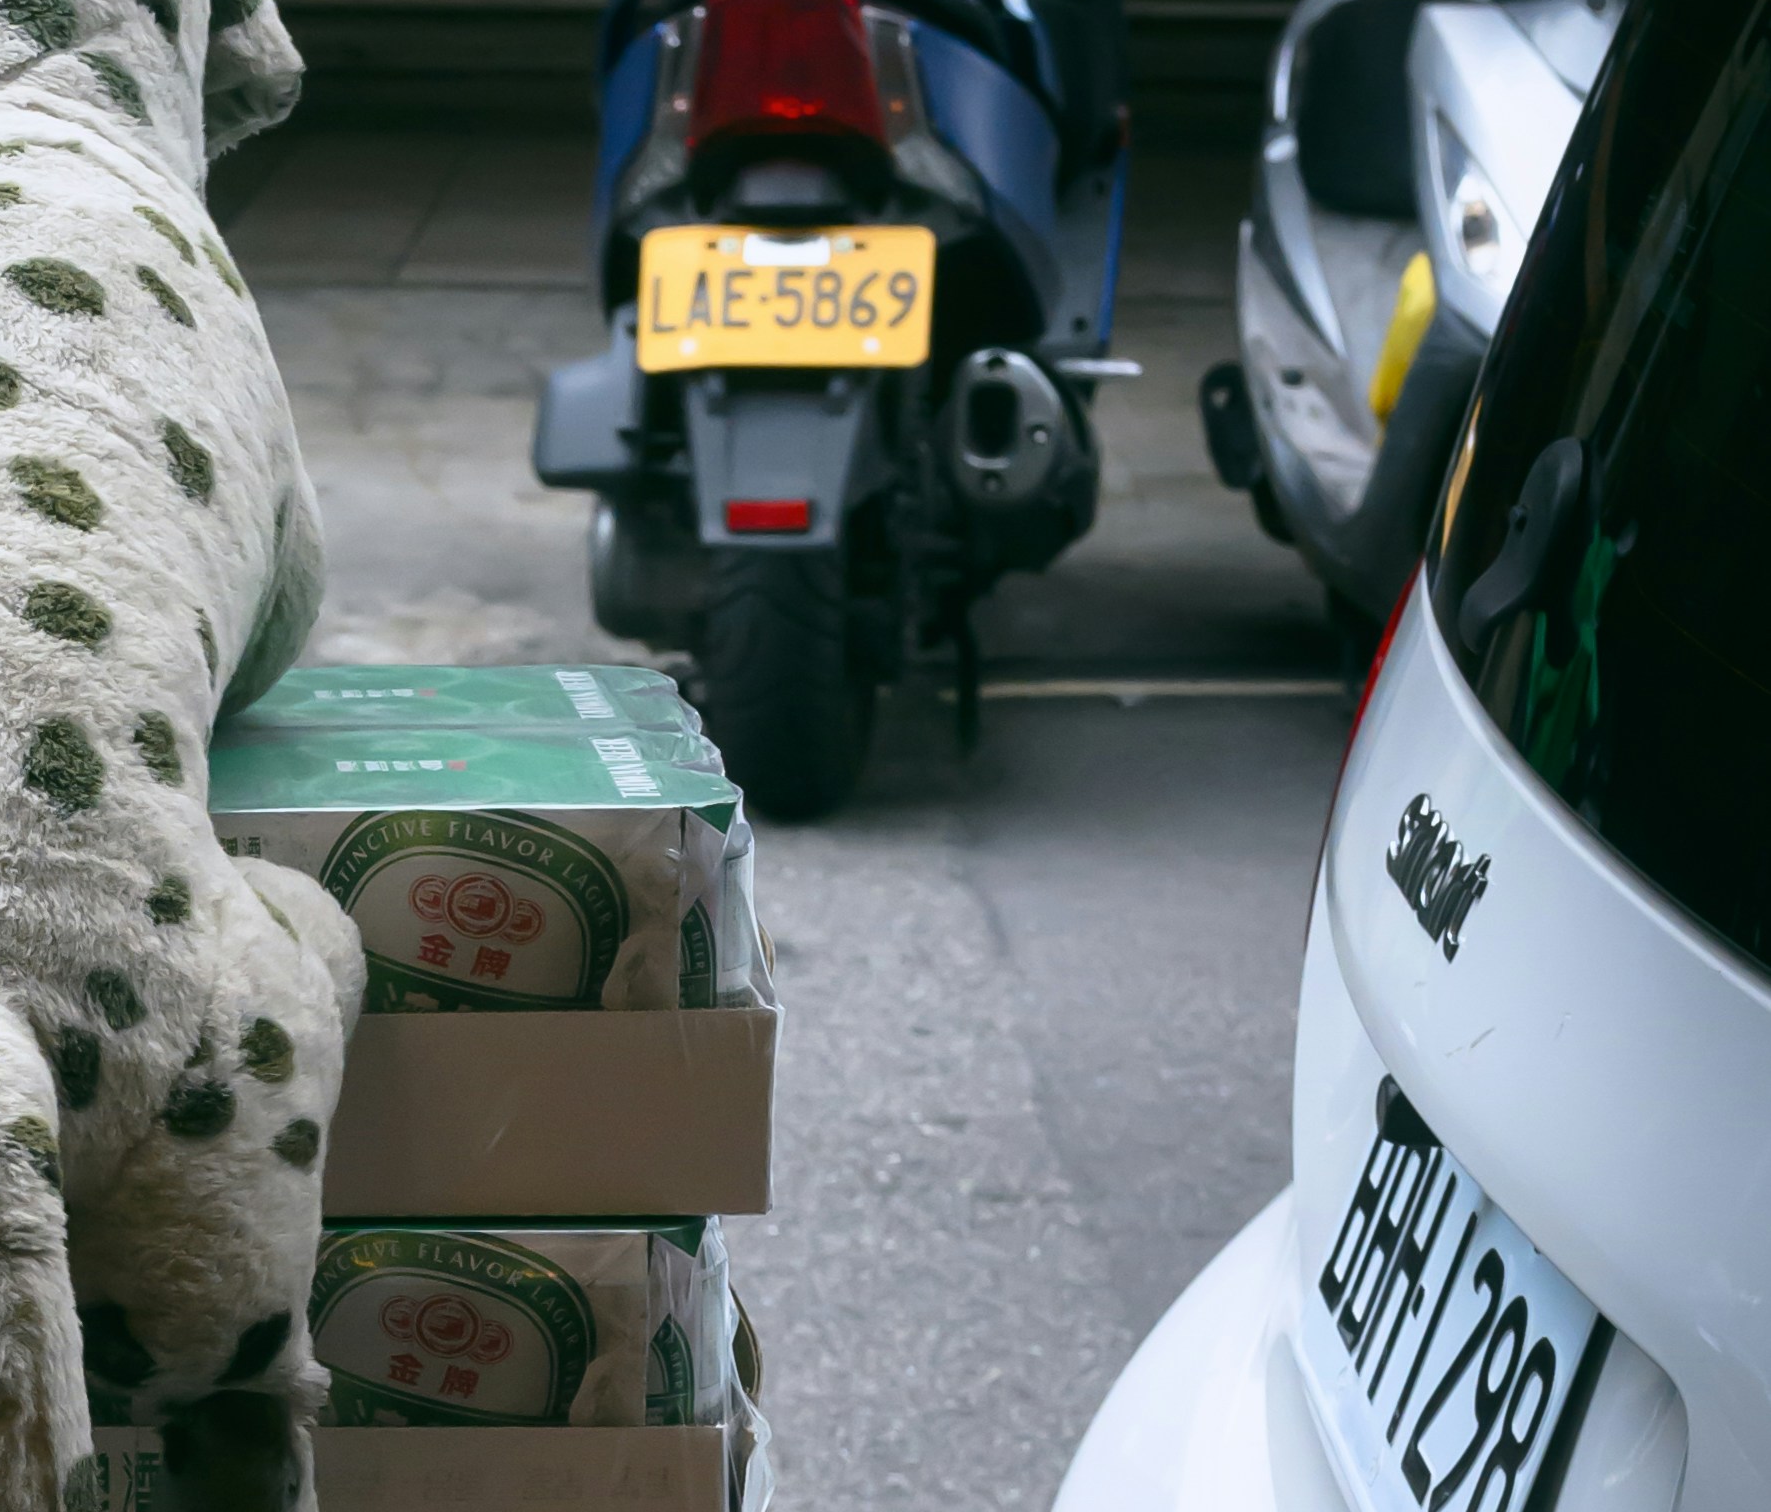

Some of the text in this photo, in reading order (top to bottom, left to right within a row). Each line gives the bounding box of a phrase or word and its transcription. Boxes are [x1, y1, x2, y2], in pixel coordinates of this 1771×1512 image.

[651, 264, 921, 334] LAE-5869
[332, 819, 614, 930] STINCTIVE FLAVOR LAGER
[416, 933, 513, 981] 金牌
[418, 1242, 524, 1288] FLAVOR
[386, 1352, 481, 1400] 金牌
